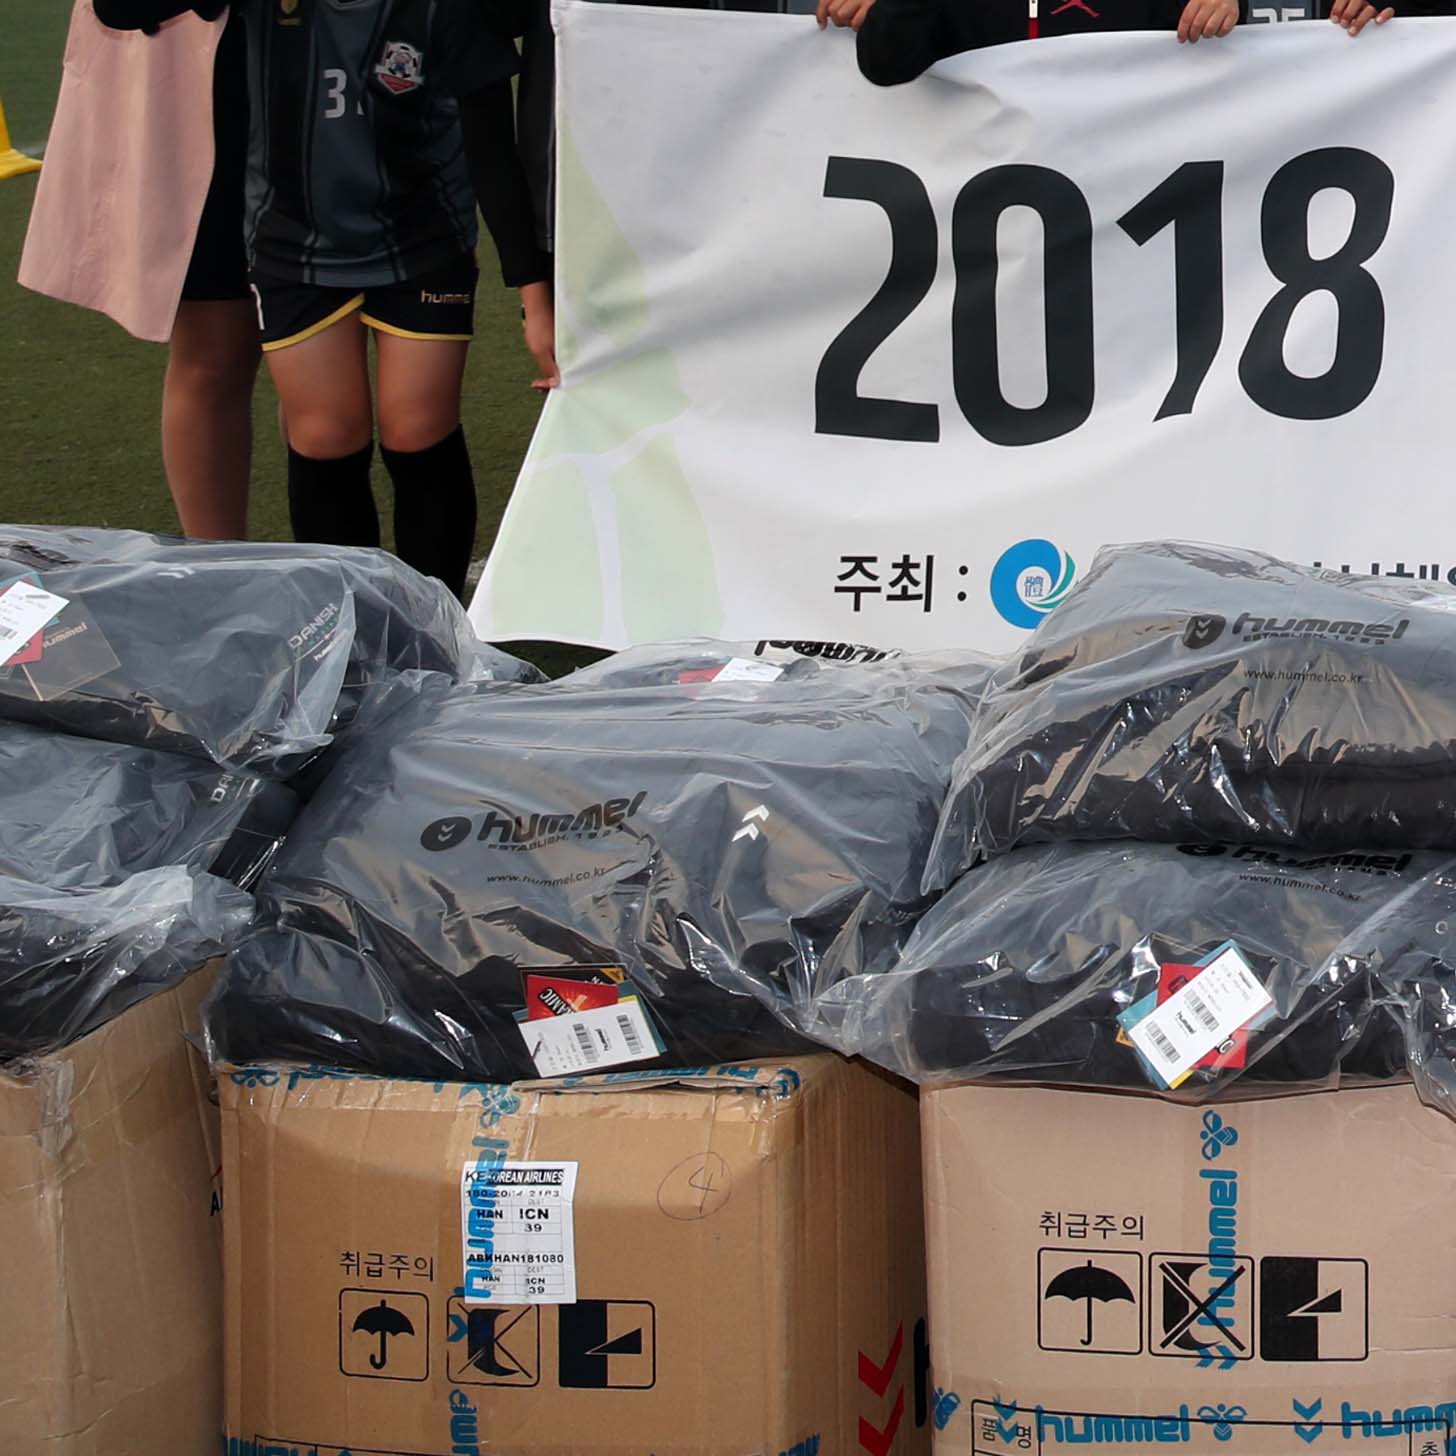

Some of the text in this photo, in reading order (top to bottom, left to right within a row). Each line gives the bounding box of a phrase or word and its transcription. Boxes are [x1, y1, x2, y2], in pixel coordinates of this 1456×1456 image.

[813, 146, 1395, 447] 2018
[835, 554, 932, 613] 주최
[288, 603, 338, 649] DANISH
[1232, 612, 1411, 640] hummel
[211, 774, 233, 803] DA
[476, 790, 648, 844] hummel
[523, 1170, 564, 1184] AIRLINES
[476, 1208, 549, 1220] HAN ICN
[523, 1223, 542, 1233] 39
[1039, 1211, 1145, 1241] 취급주의
[1197, 1168, 1239, 1328] hummel
[339, 1251, 435, 1282] 취급주의
[527, 1286, 545, 1295] 39
[1035, 1403, 1191, 1444] hummel
